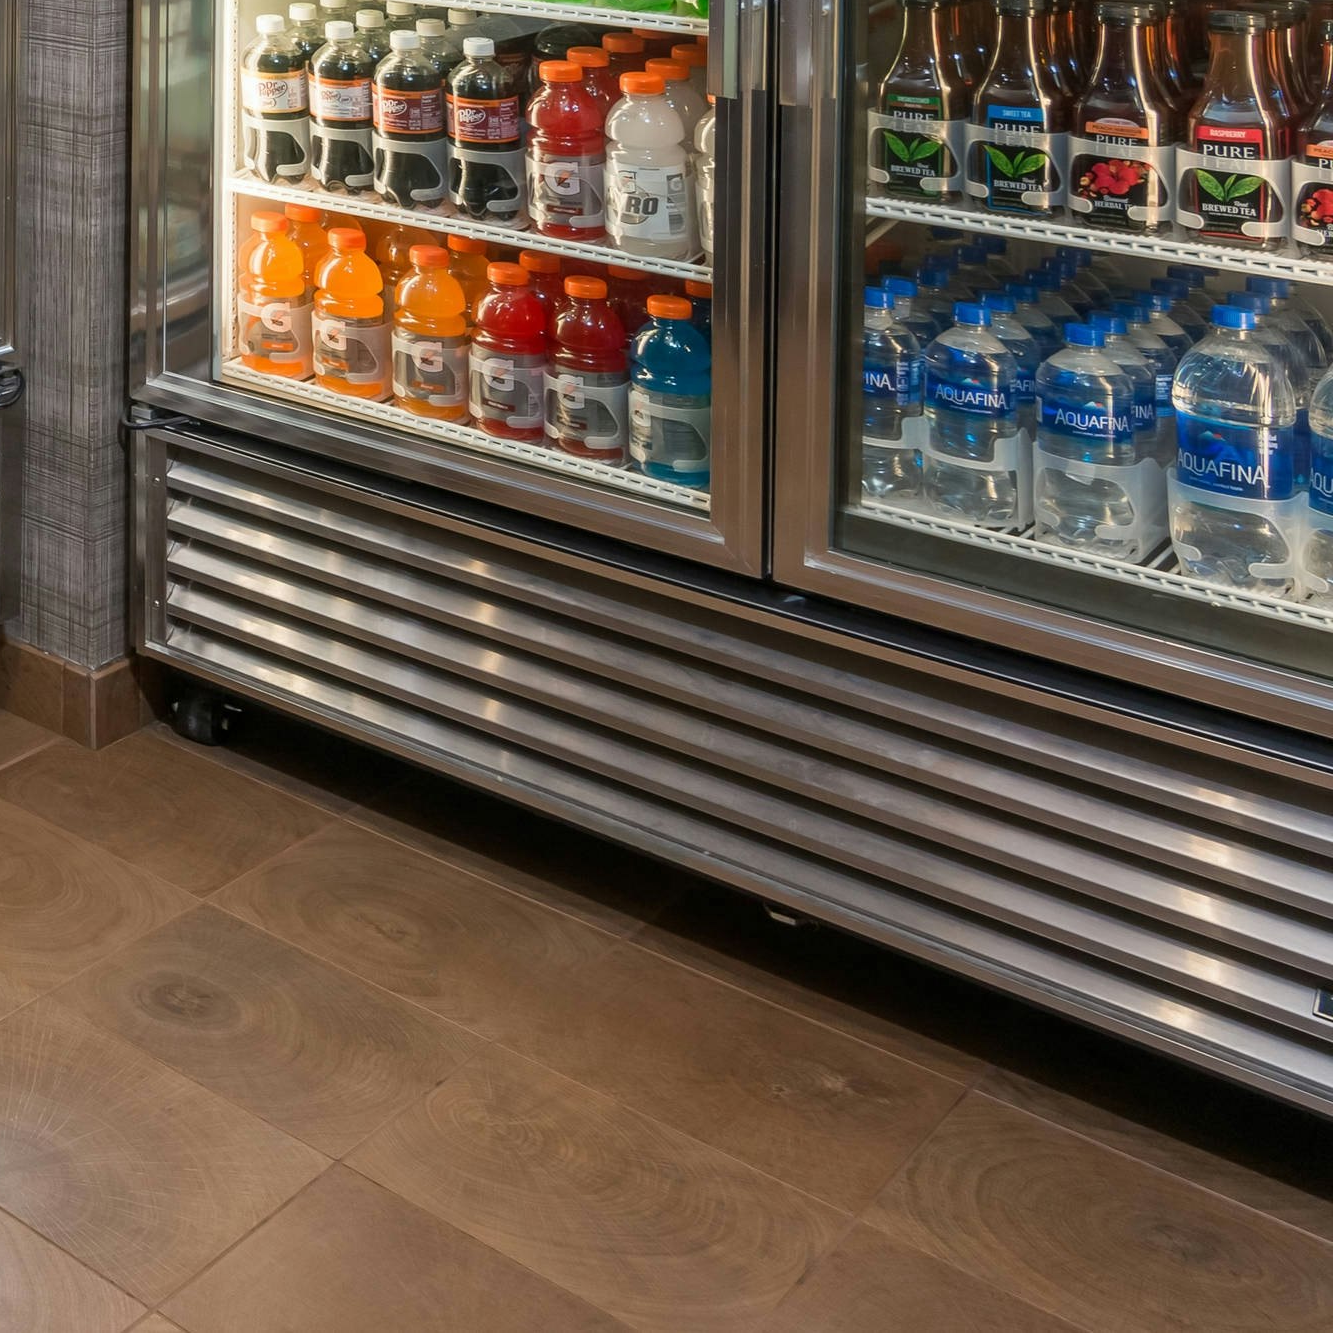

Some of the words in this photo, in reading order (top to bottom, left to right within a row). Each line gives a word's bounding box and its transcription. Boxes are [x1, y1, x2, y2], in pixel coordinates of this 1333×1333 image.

[994, 123, 1041, 134] PURE
[1209, 130, 1246, 138] RASPBERRY
[1203, 144, 1255, 159] PURE
[891, 165, 920, 175] BREWED
[922, 169, 935, 177] TEA
[994, 180, 1027, 190] BREWED
[1029, 184, 1043, 192] TEA
[1202, 202, 1238, 214] BREWED
[1239, 207, 1257, 216] TEA
[935, 385, 1010, 410] AQUAFINA
[1054, 409, 1131, 433] AQUAFINA
[1177, 452, 1269, 485] AQUAFINA
